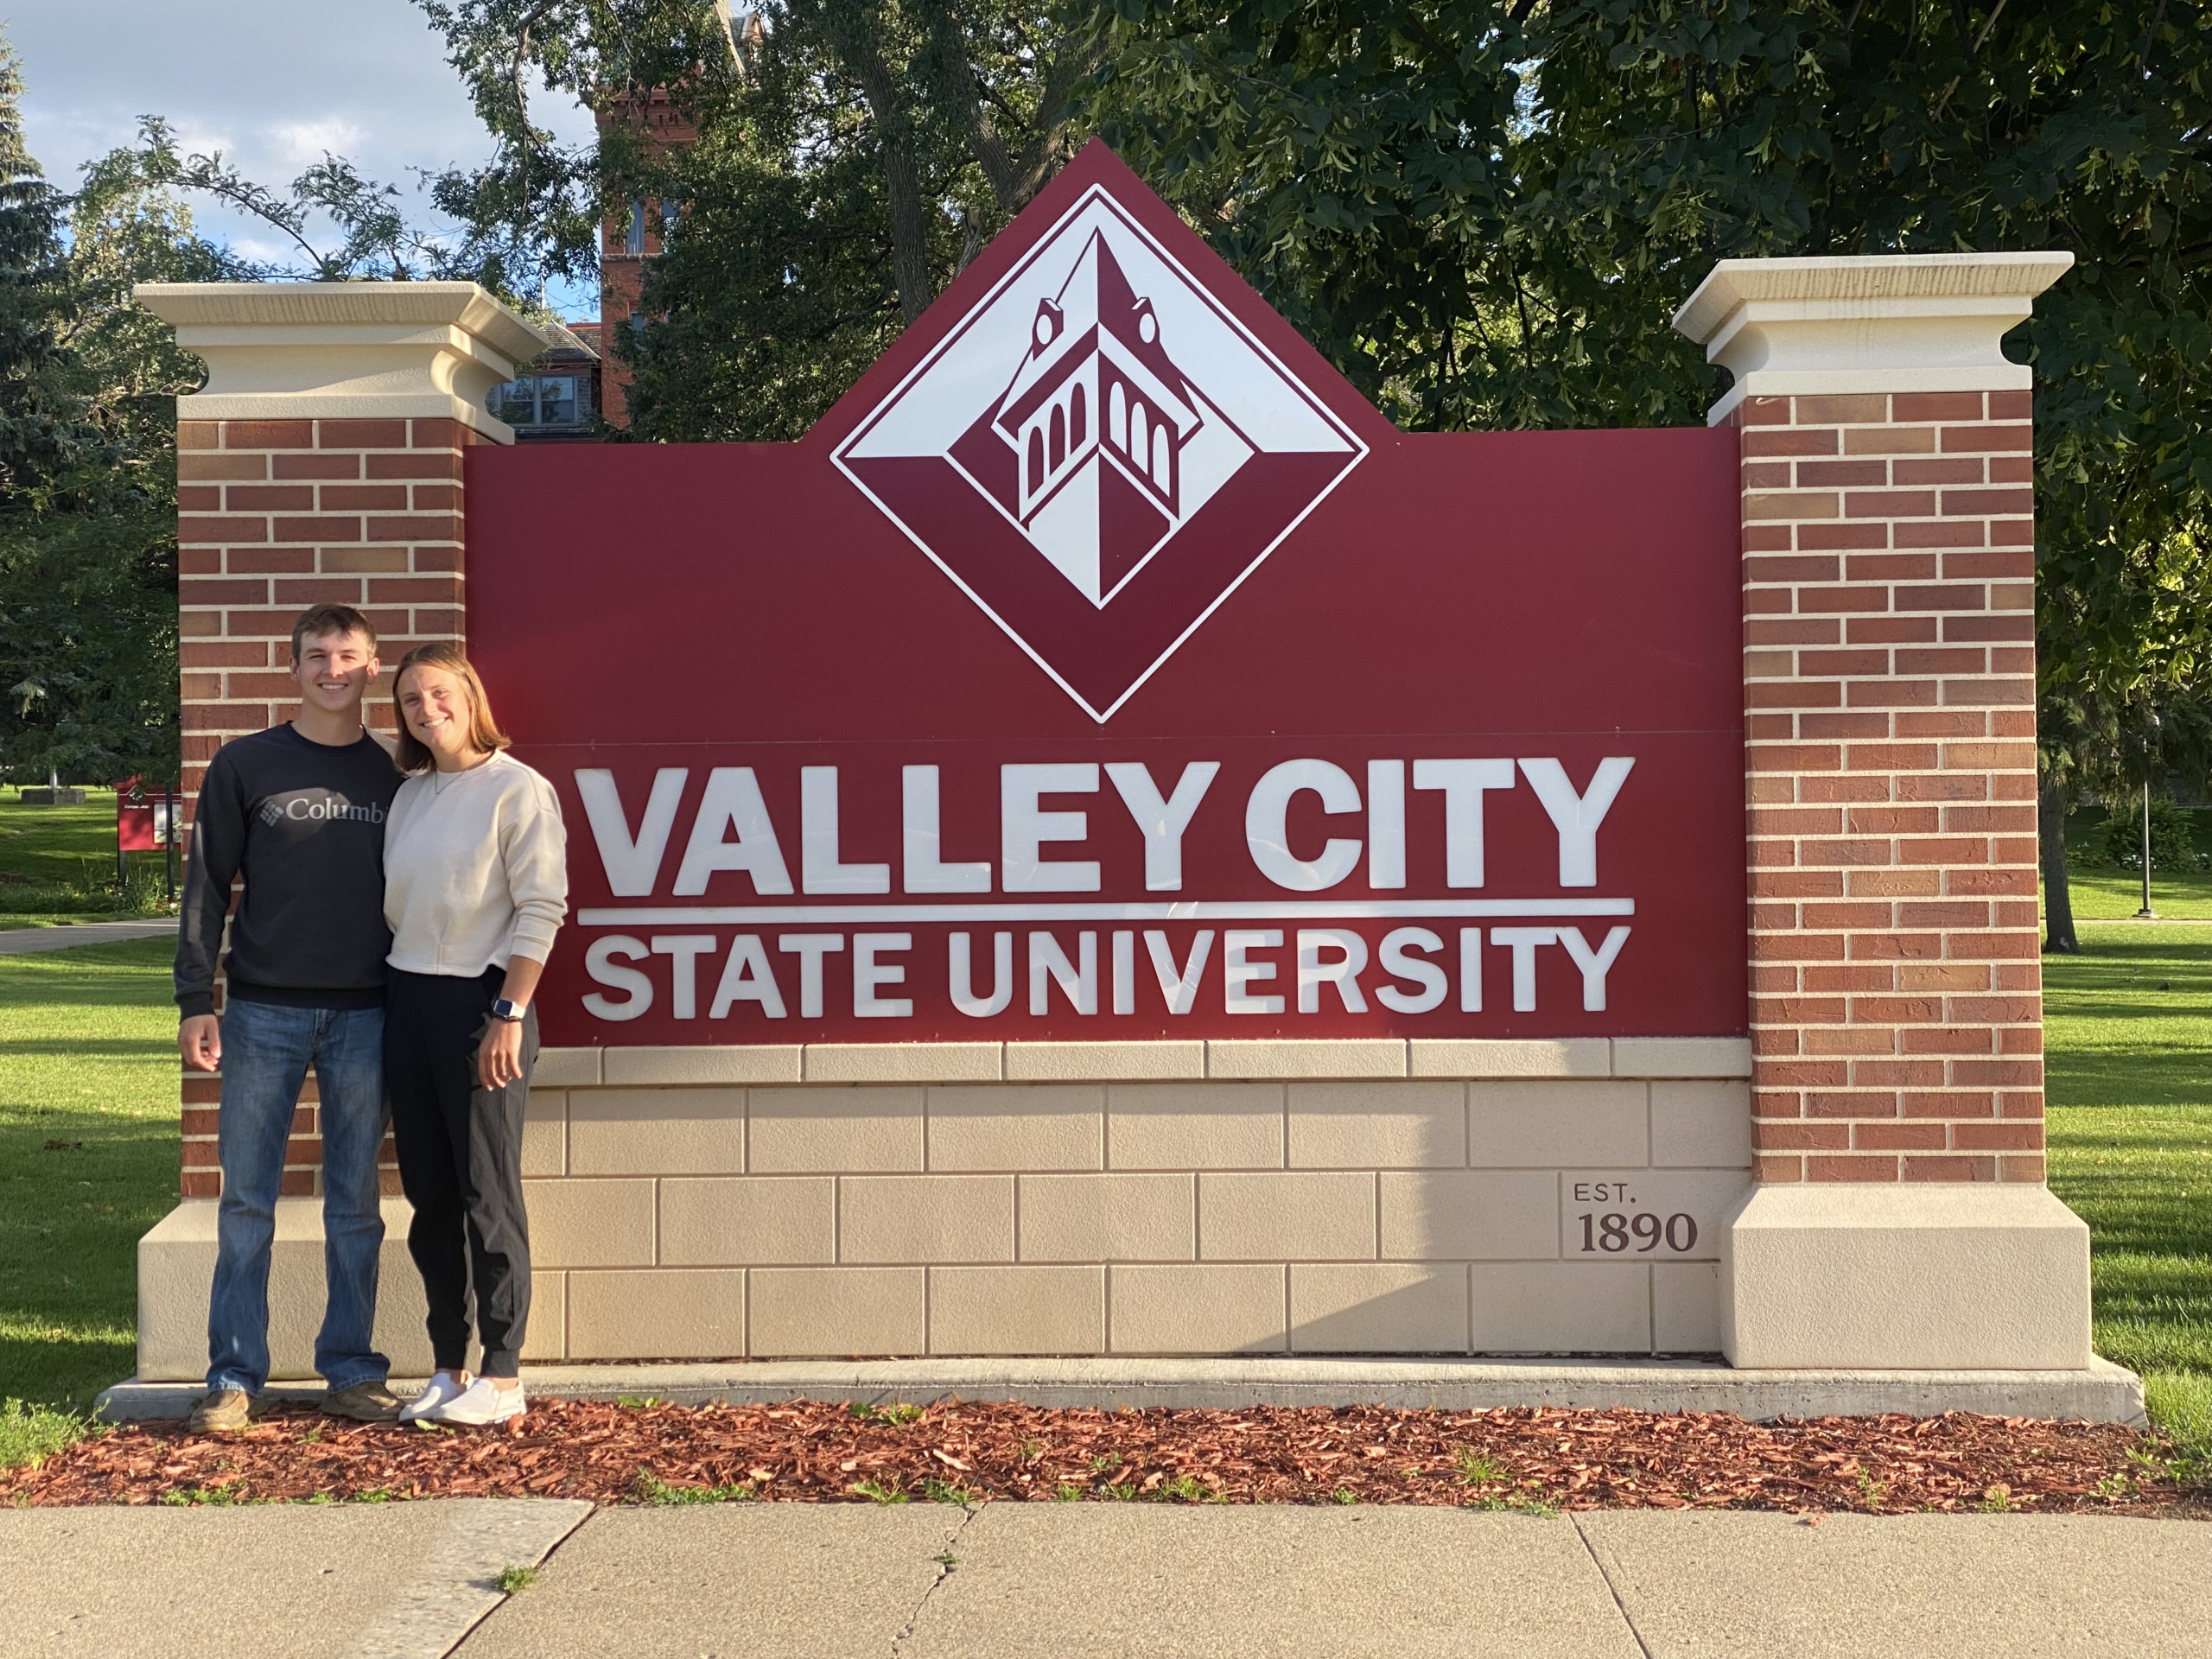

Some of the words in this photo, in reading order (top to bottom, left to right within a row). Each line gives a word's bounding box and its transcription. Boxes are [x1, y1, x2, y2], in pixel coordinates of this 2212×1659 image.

[573, 762, 1222, 897] VALLEY
[1244, 755, 1637, 893] CITY
[581, 931, 915, 1021] STATE
[947, 925, 1632, 1019] UNIVERSITY
[1574, 1183, 1637, 1203] EST.
[1578, 1213, 1698, 1252] 1890
